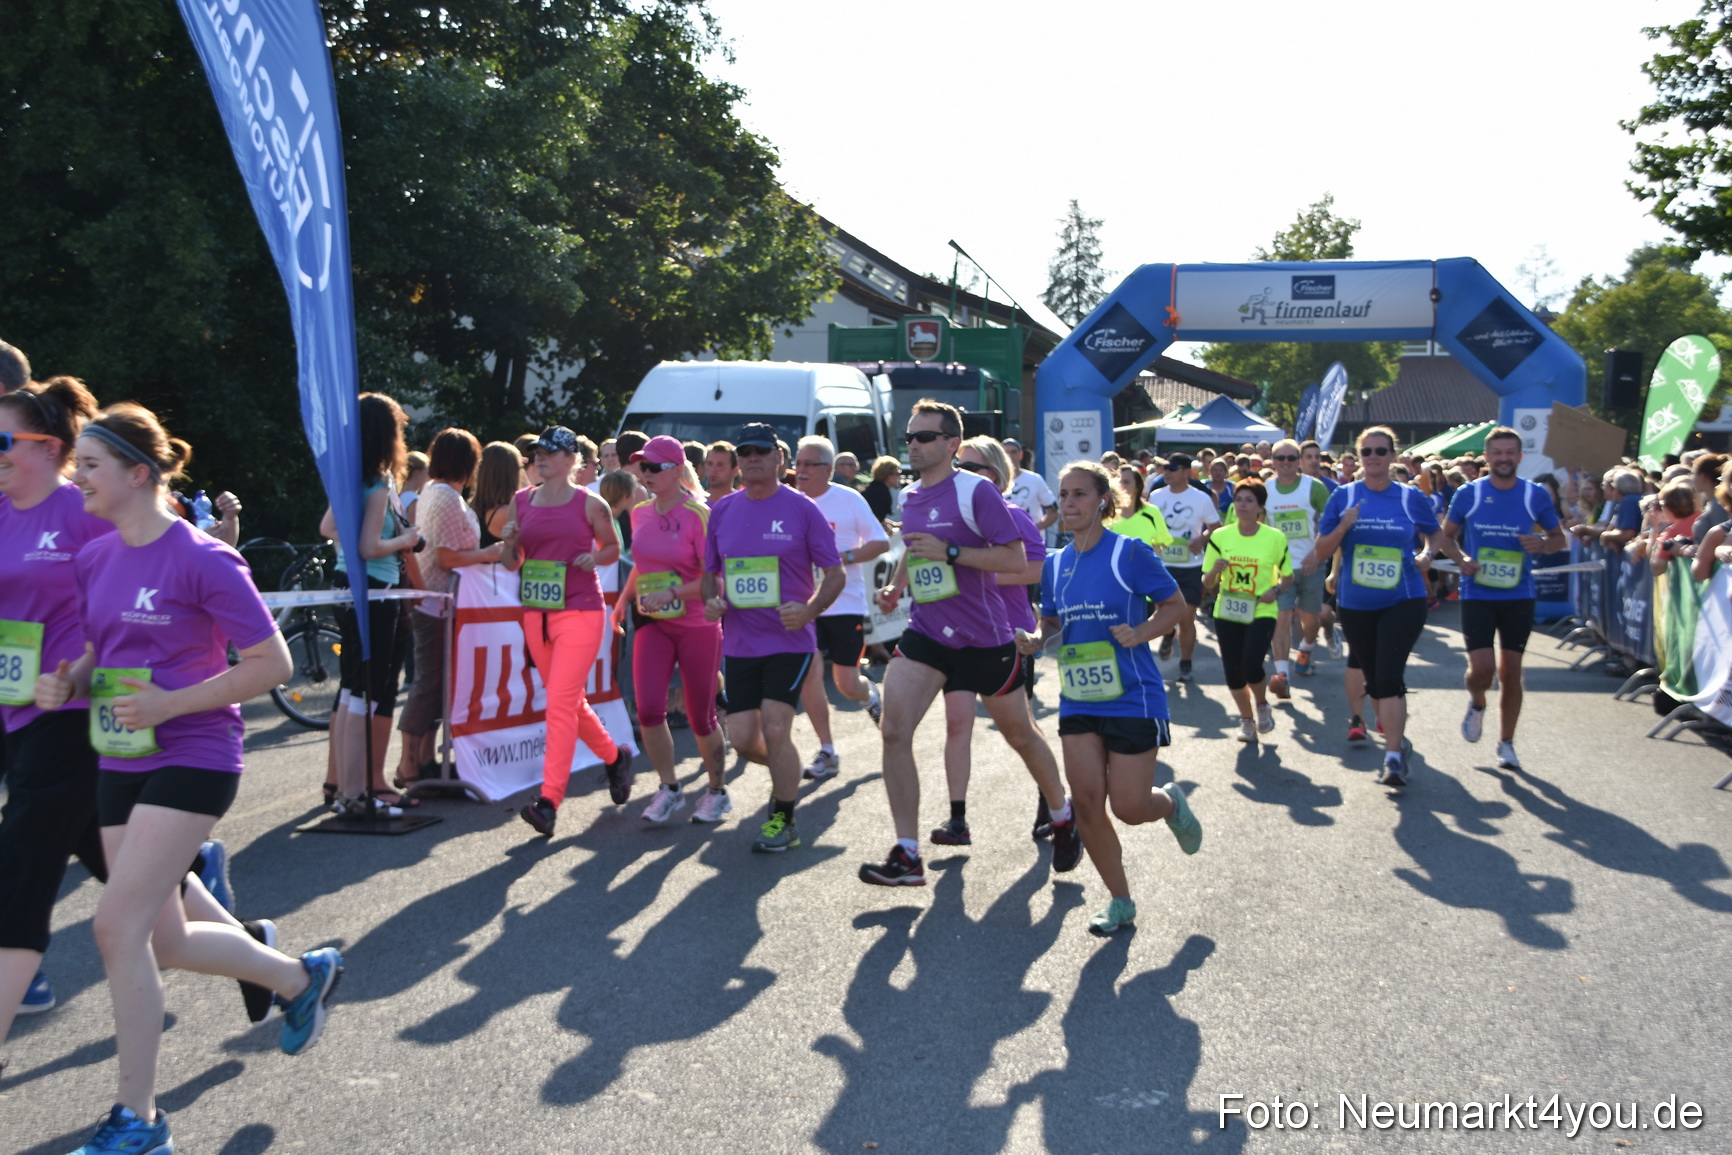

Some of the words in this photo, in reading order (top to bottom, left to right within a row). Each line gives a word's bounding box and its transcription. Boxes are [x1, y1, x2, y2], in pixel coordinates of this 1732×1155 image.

[1275, 299, 1373, 318] firmenlauf
[1094, 336, 1145, 348] Fischer
[1677, 379, 1707, 412] AOK
[1645, 402, 1680, 441] AOK
[771, 520, 784, 533] K
[1281, 521, 1302, 532] 578
[37, 531, 60, 550] K
[1230, 555, 1258, 563] Müller
[915, 566, 943, 587] 499
[1235, 571, 1250, 585] M
[1357, 561, 1396, 578] 1356
[1481, 563, 1516, 579] 1354
[524, 581, 562, 602] 5199
[736, 577, 768, 594] 686
[134, 587, 159, 611] K
[1226, 599, 1248, 614] 338
[1065, 665, 1114, 687] 1355
